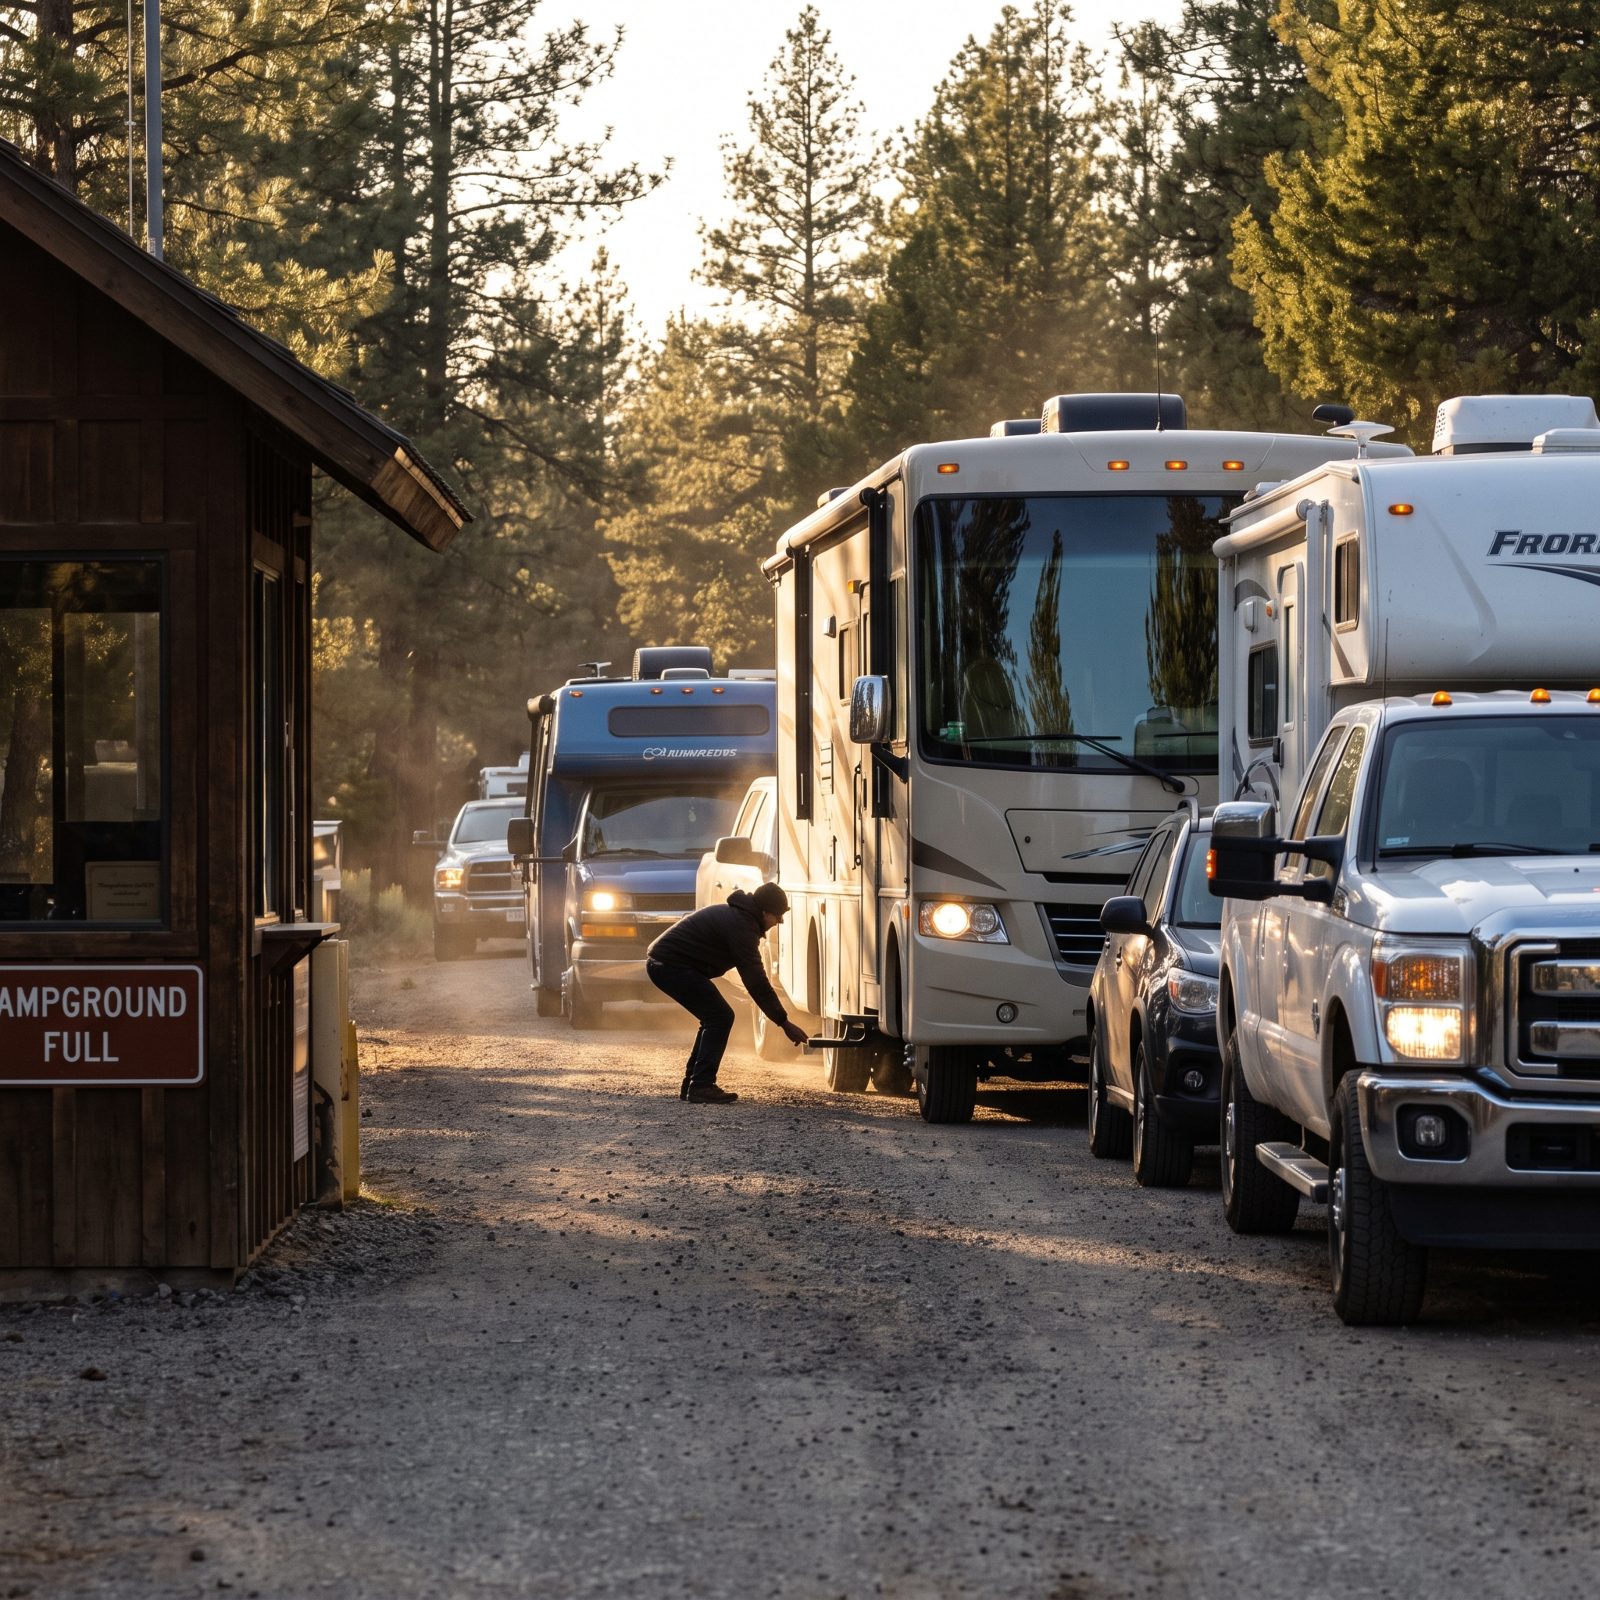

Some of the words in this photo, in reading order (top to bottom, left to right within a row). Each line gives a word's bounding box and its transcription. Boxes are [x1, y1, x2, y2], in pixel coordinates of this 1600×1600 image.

[1487, 530, 1600, 556] FROR
[0, 986, 187, 1018] AMPGROUND
[44, 1031, 119, 1062] FULL
